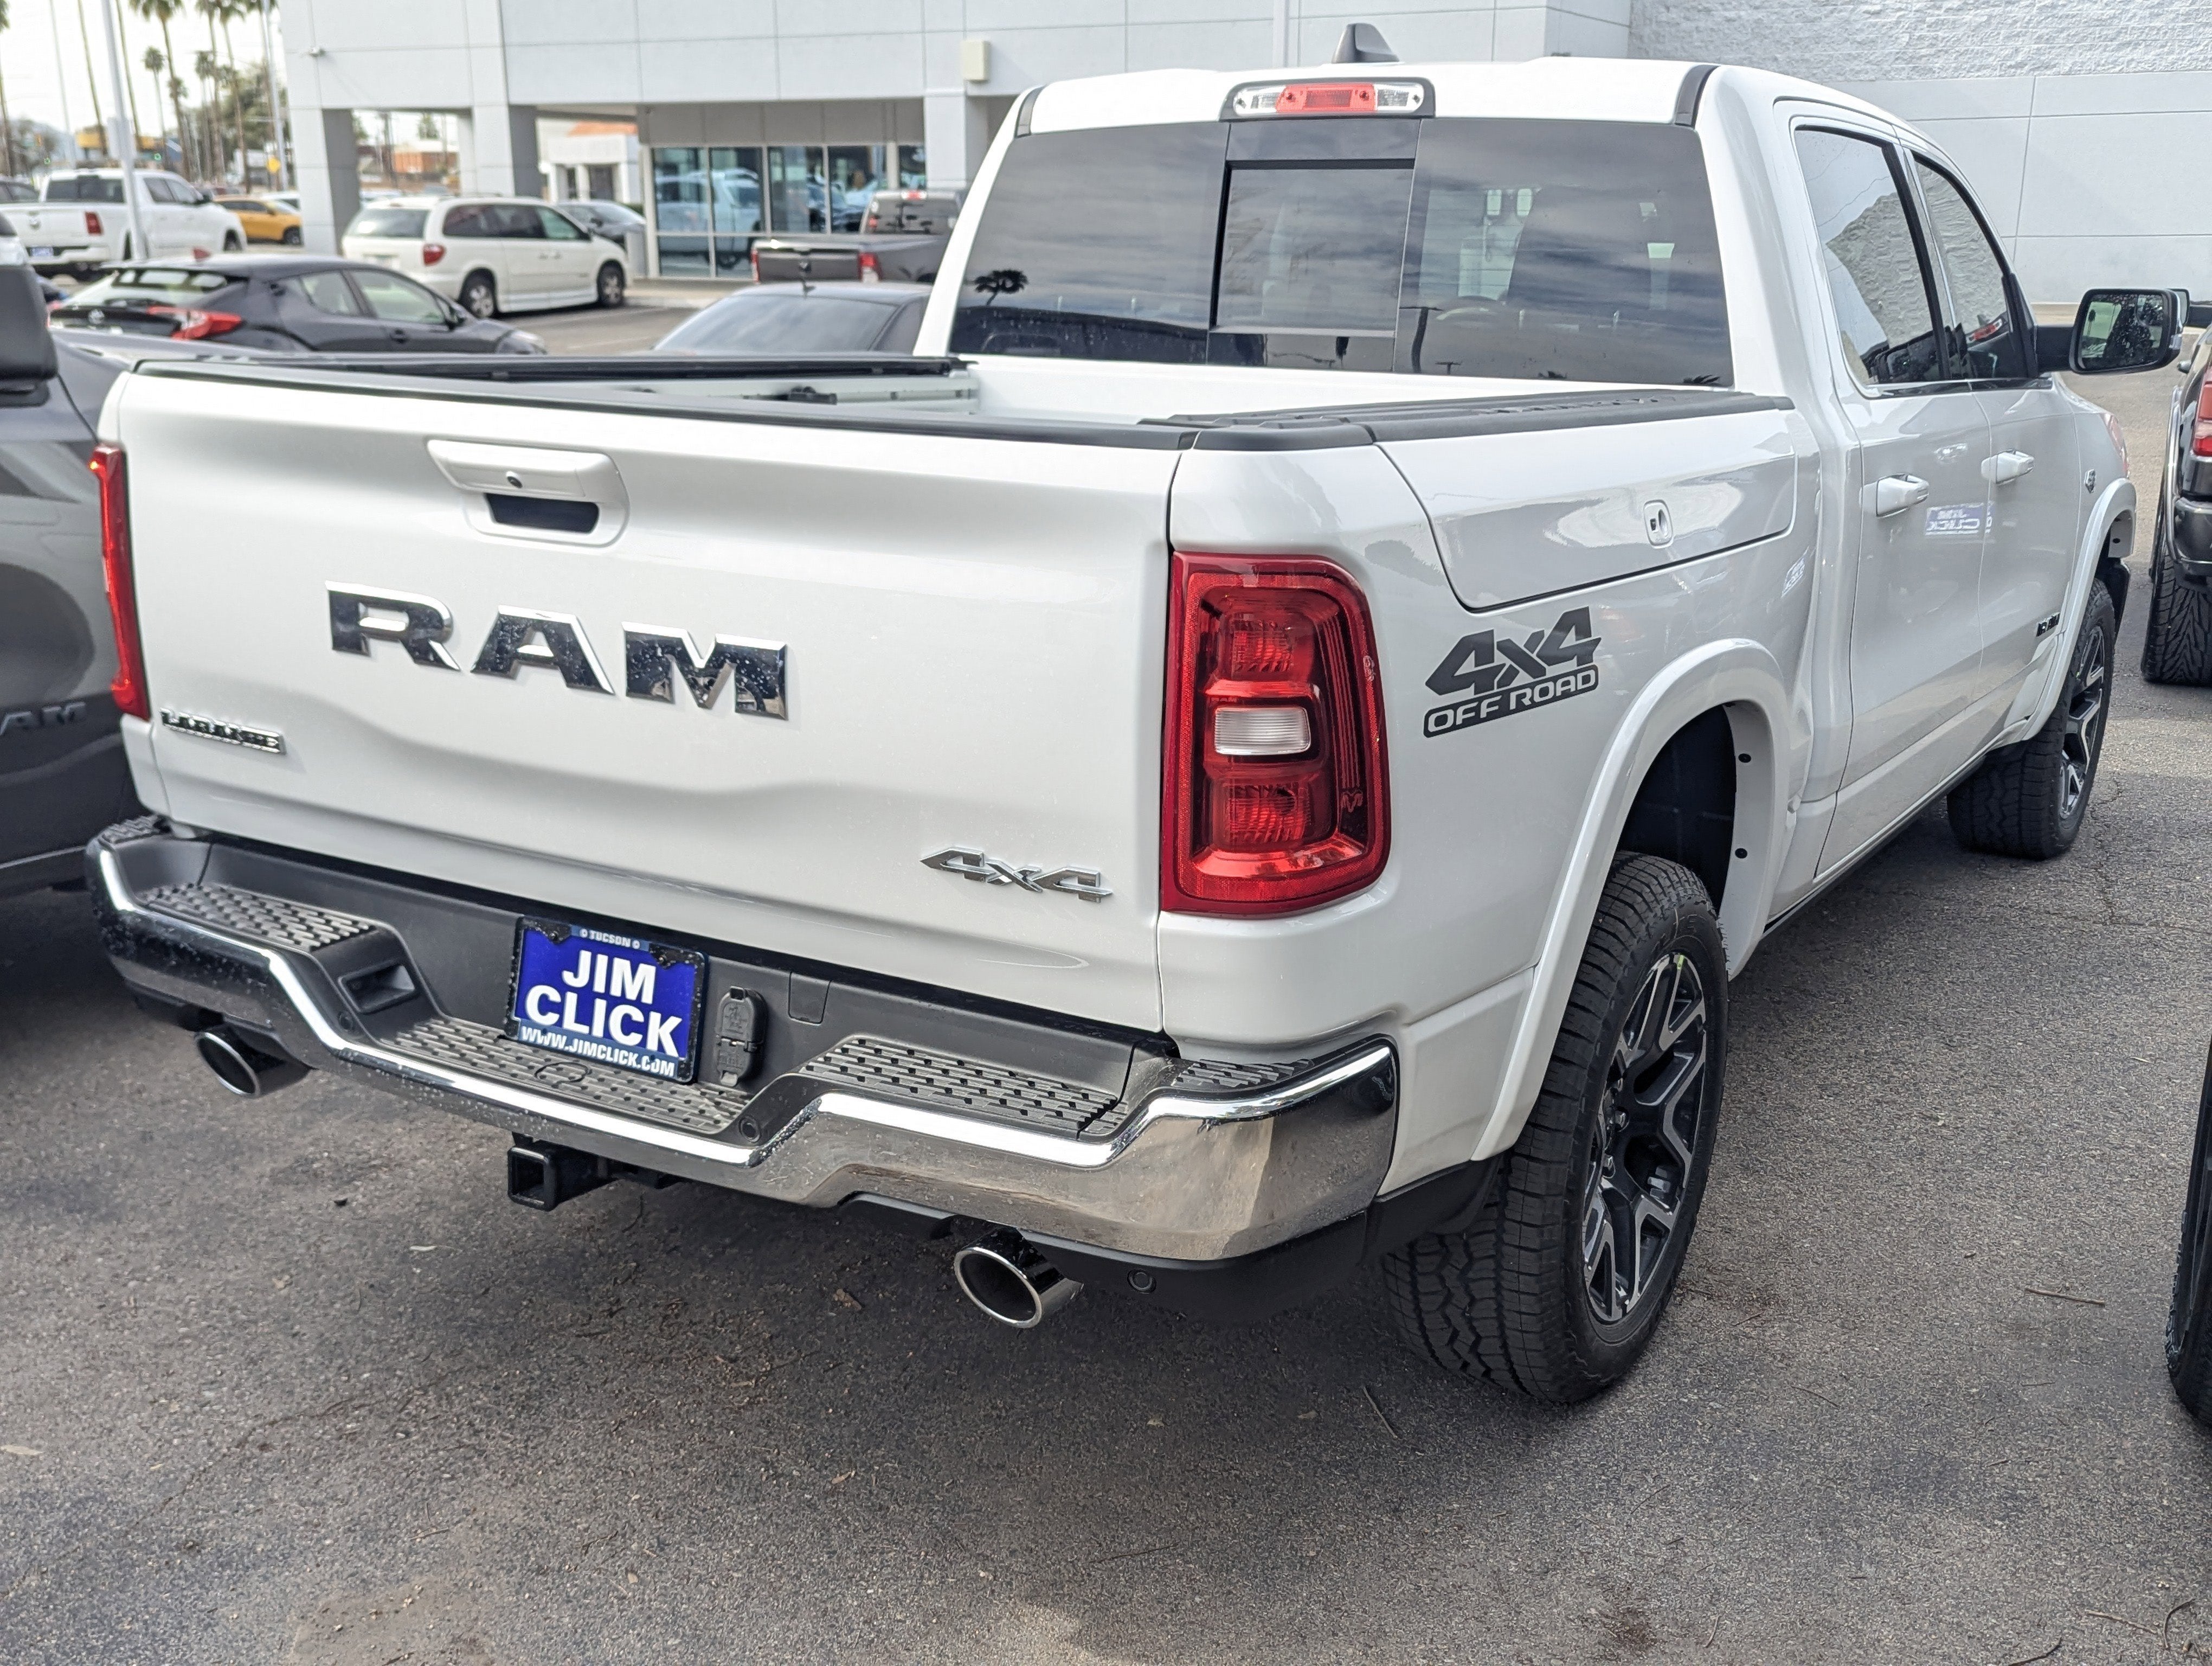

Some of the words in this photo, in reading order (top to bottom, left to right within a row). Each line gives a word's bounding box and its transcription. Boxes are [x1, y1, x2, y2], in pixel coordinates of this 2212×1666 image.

[325, 580, 788, 720] RAM
[1427, 695, 1502, 733] OFF
[1509, 669, 1596, 710] ROAD
[589, 930, 632, 948] TUCSON
[562, 950, 657, 1004] JIM
[525, 984, 683, 1058] CLICK
[522, 1026, 676, 1078] WWW.JIMCLICK.COM
